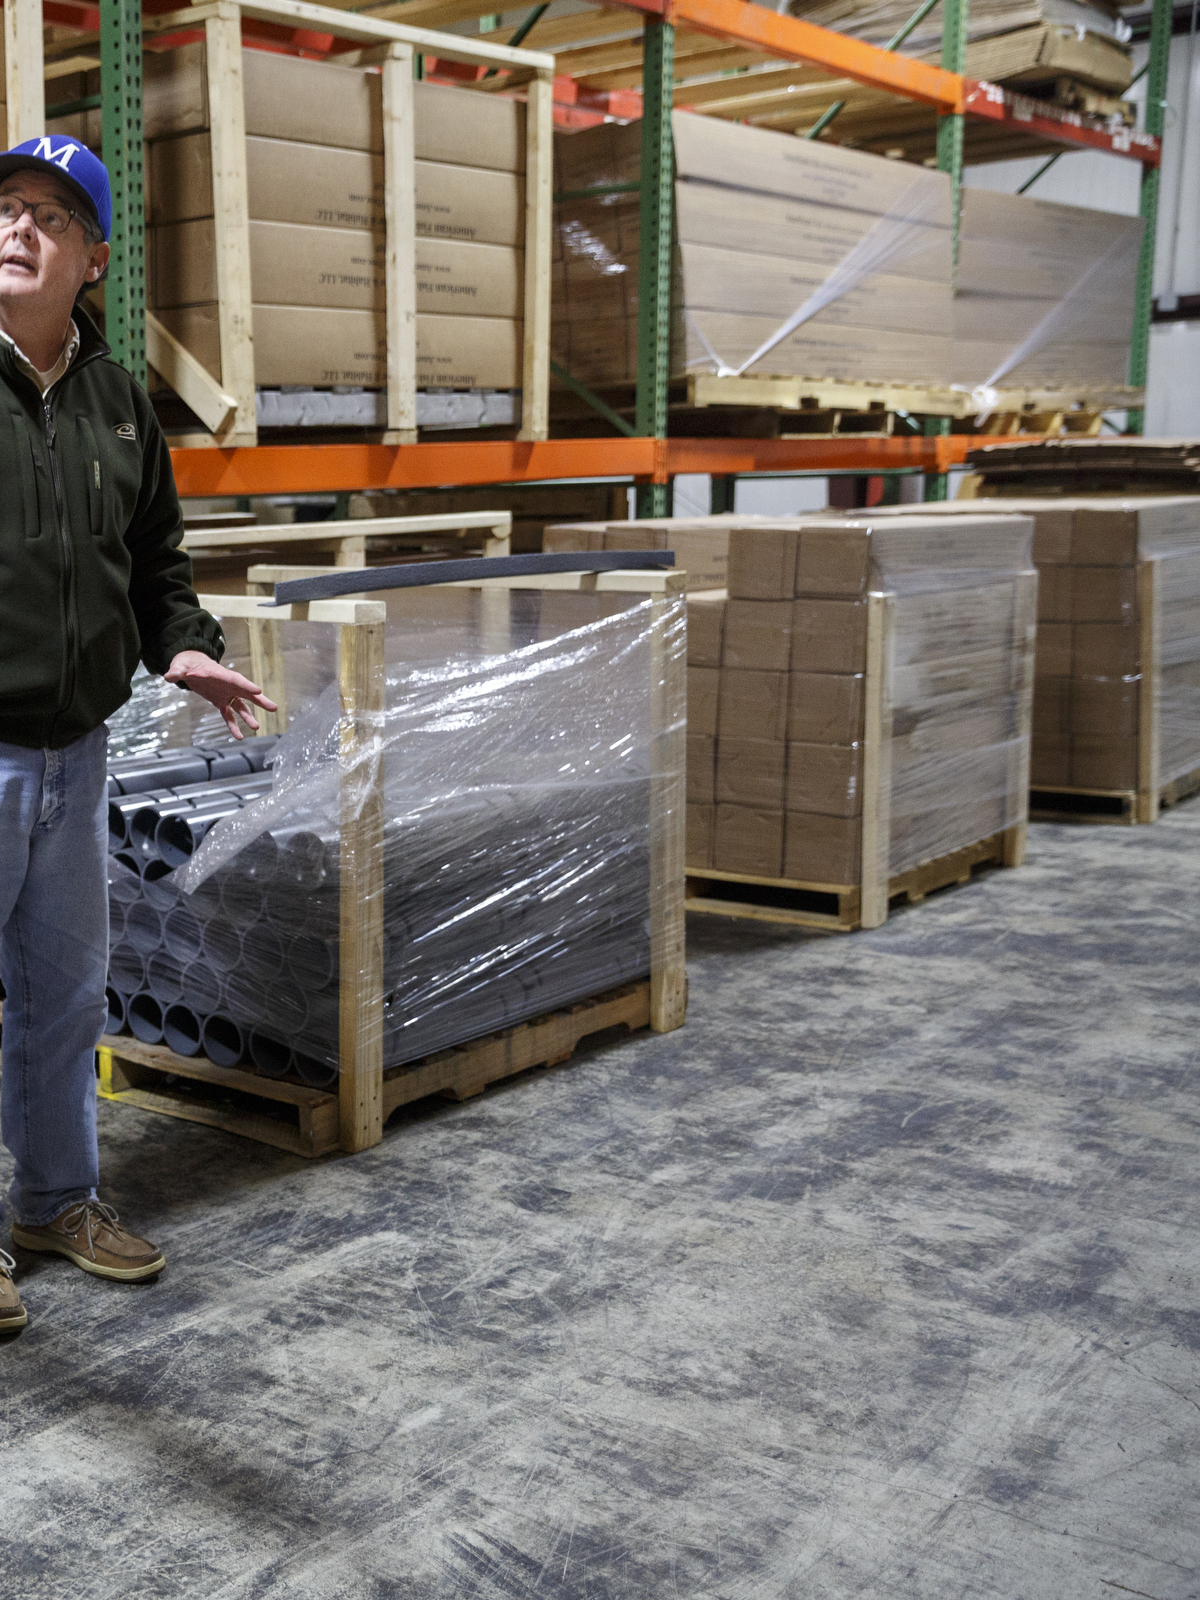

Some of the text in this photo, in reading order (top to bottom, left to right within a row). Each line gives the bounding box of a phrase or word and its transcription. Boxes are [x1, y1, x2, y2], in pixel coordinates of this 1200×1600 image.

[32, 136, 80, 172] M
[434, 222, 477, 238] American
[434, 282, 477, 297] American
